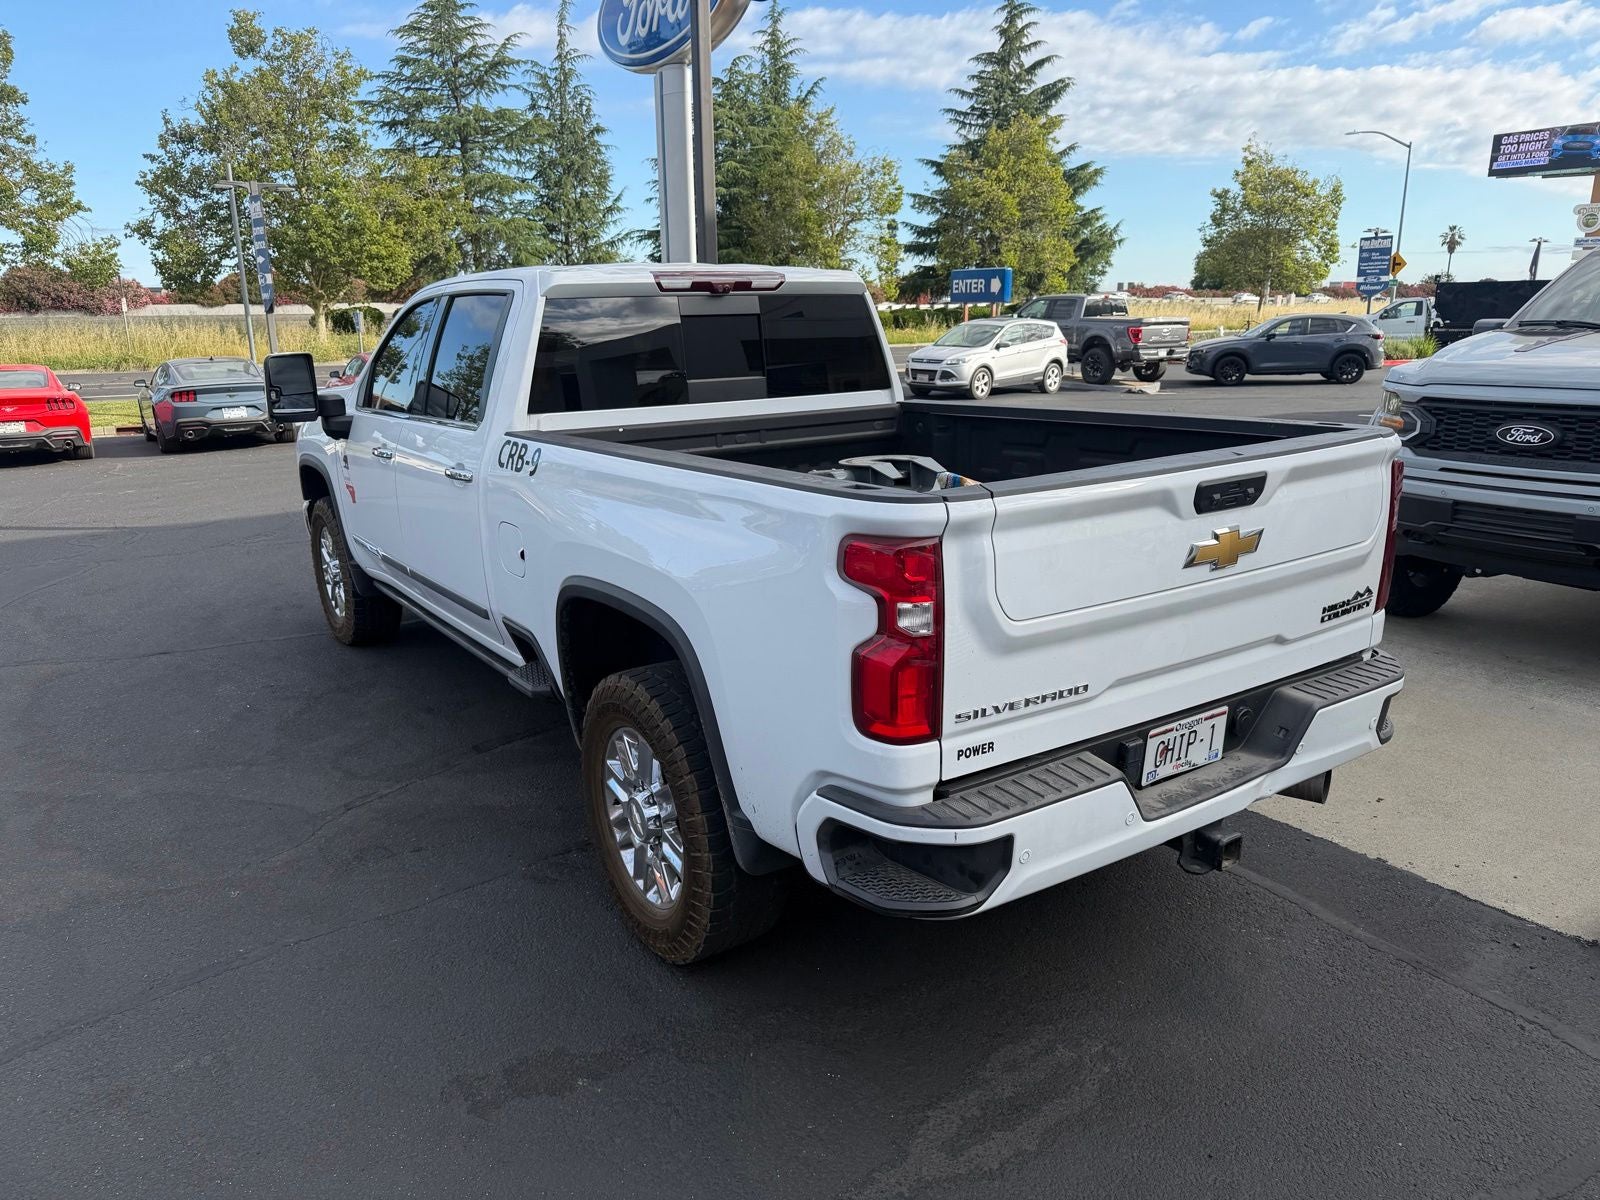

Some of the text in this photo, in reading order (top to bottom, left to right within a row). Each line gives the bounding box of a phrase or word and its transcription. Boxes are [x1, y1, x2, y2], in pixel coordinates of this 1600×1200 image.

[1501, 131, 1550, 144] GAS PRICES
[1500, 141, 1547, 153] TOO HIGH?
[1495, 158, 1548, 168] MUSTANG MACH-E
[952, 278, 985, 294] ENTER
[1506, 427, 1543, 444] Ford
[497, 439, 542, 477] CRB-9
[1320, 599, 1373, 623] COUNTRY
[1321, 598, 1351, 614] HIGH
[954, 684, 1089, 724] SILVERADO
[1175, 717, 1203, 732] Oregon
[957, 741, 995, 761] POWER
